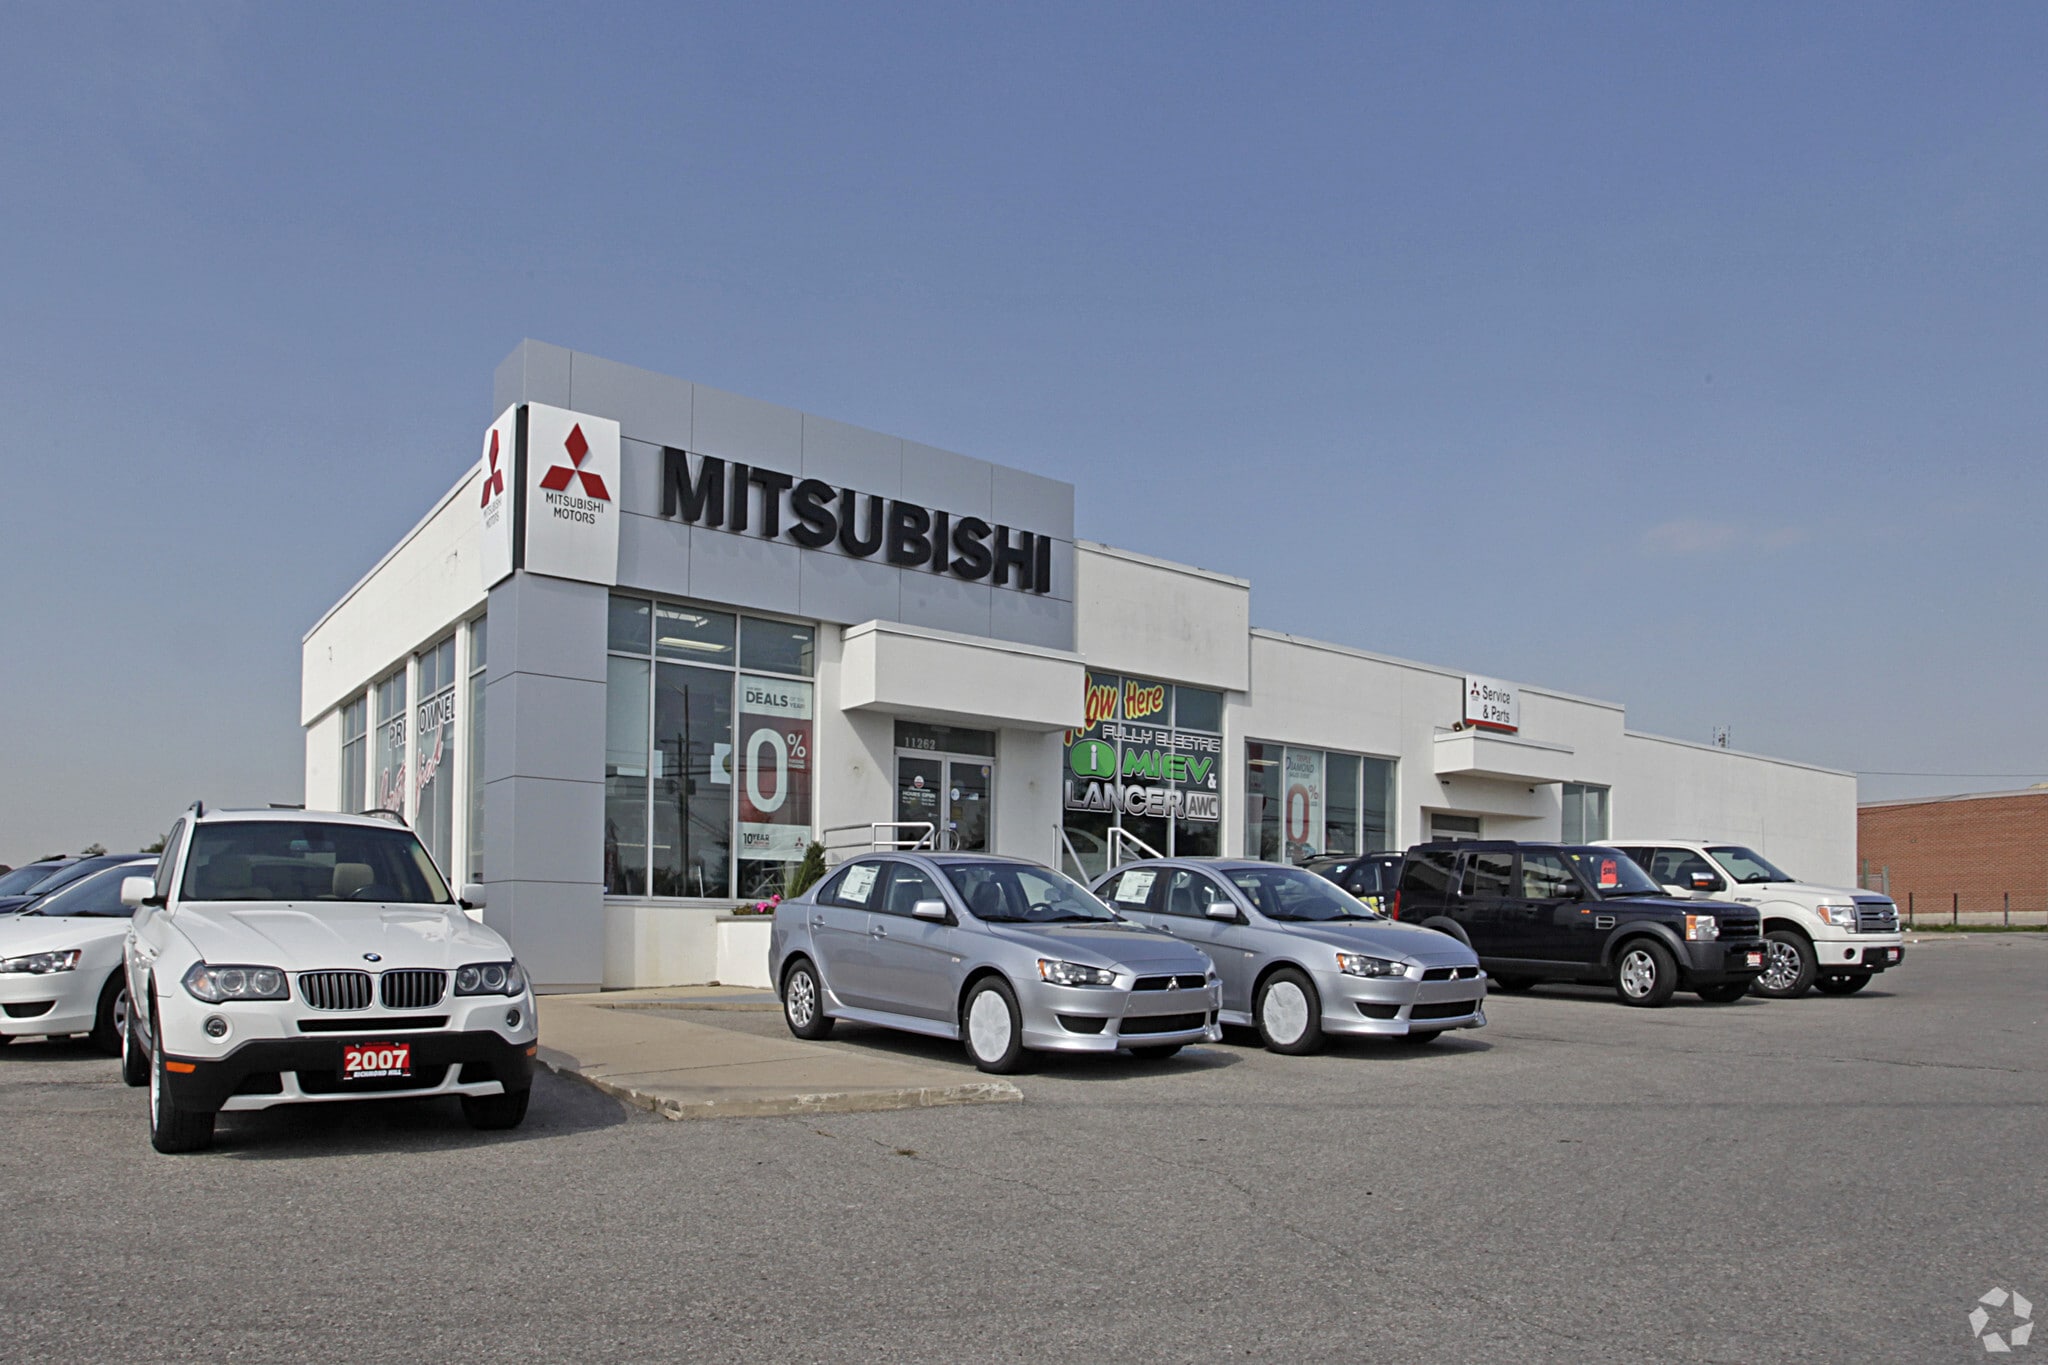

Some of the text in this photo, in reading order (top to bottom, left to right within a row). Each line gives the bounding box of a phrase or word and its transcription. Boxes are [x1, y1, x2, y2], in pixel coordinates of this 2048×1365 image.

[546, 492, 604, 513] MITSUBISHI
[553, 508, 595, 525] MOTORS
[661, 445, 1051, 593] MITSUBISHI
[746, 691, 788, 707] DEALS
[1124, 681, 1164, 719] Here
[1482, 685, 1510, 704] Service
[1482, 704, 1510, 723] & Parts
[905, 737, 936, 750] 11262
[1103, 724, 1152, 744] FULLY
[1207, 772, 1217, 789] &
[1065, 780, 1217, 819] LANCER AWC
[743, 833, 753, 845] 10
[346, 1050, 407, 1071] 2007
